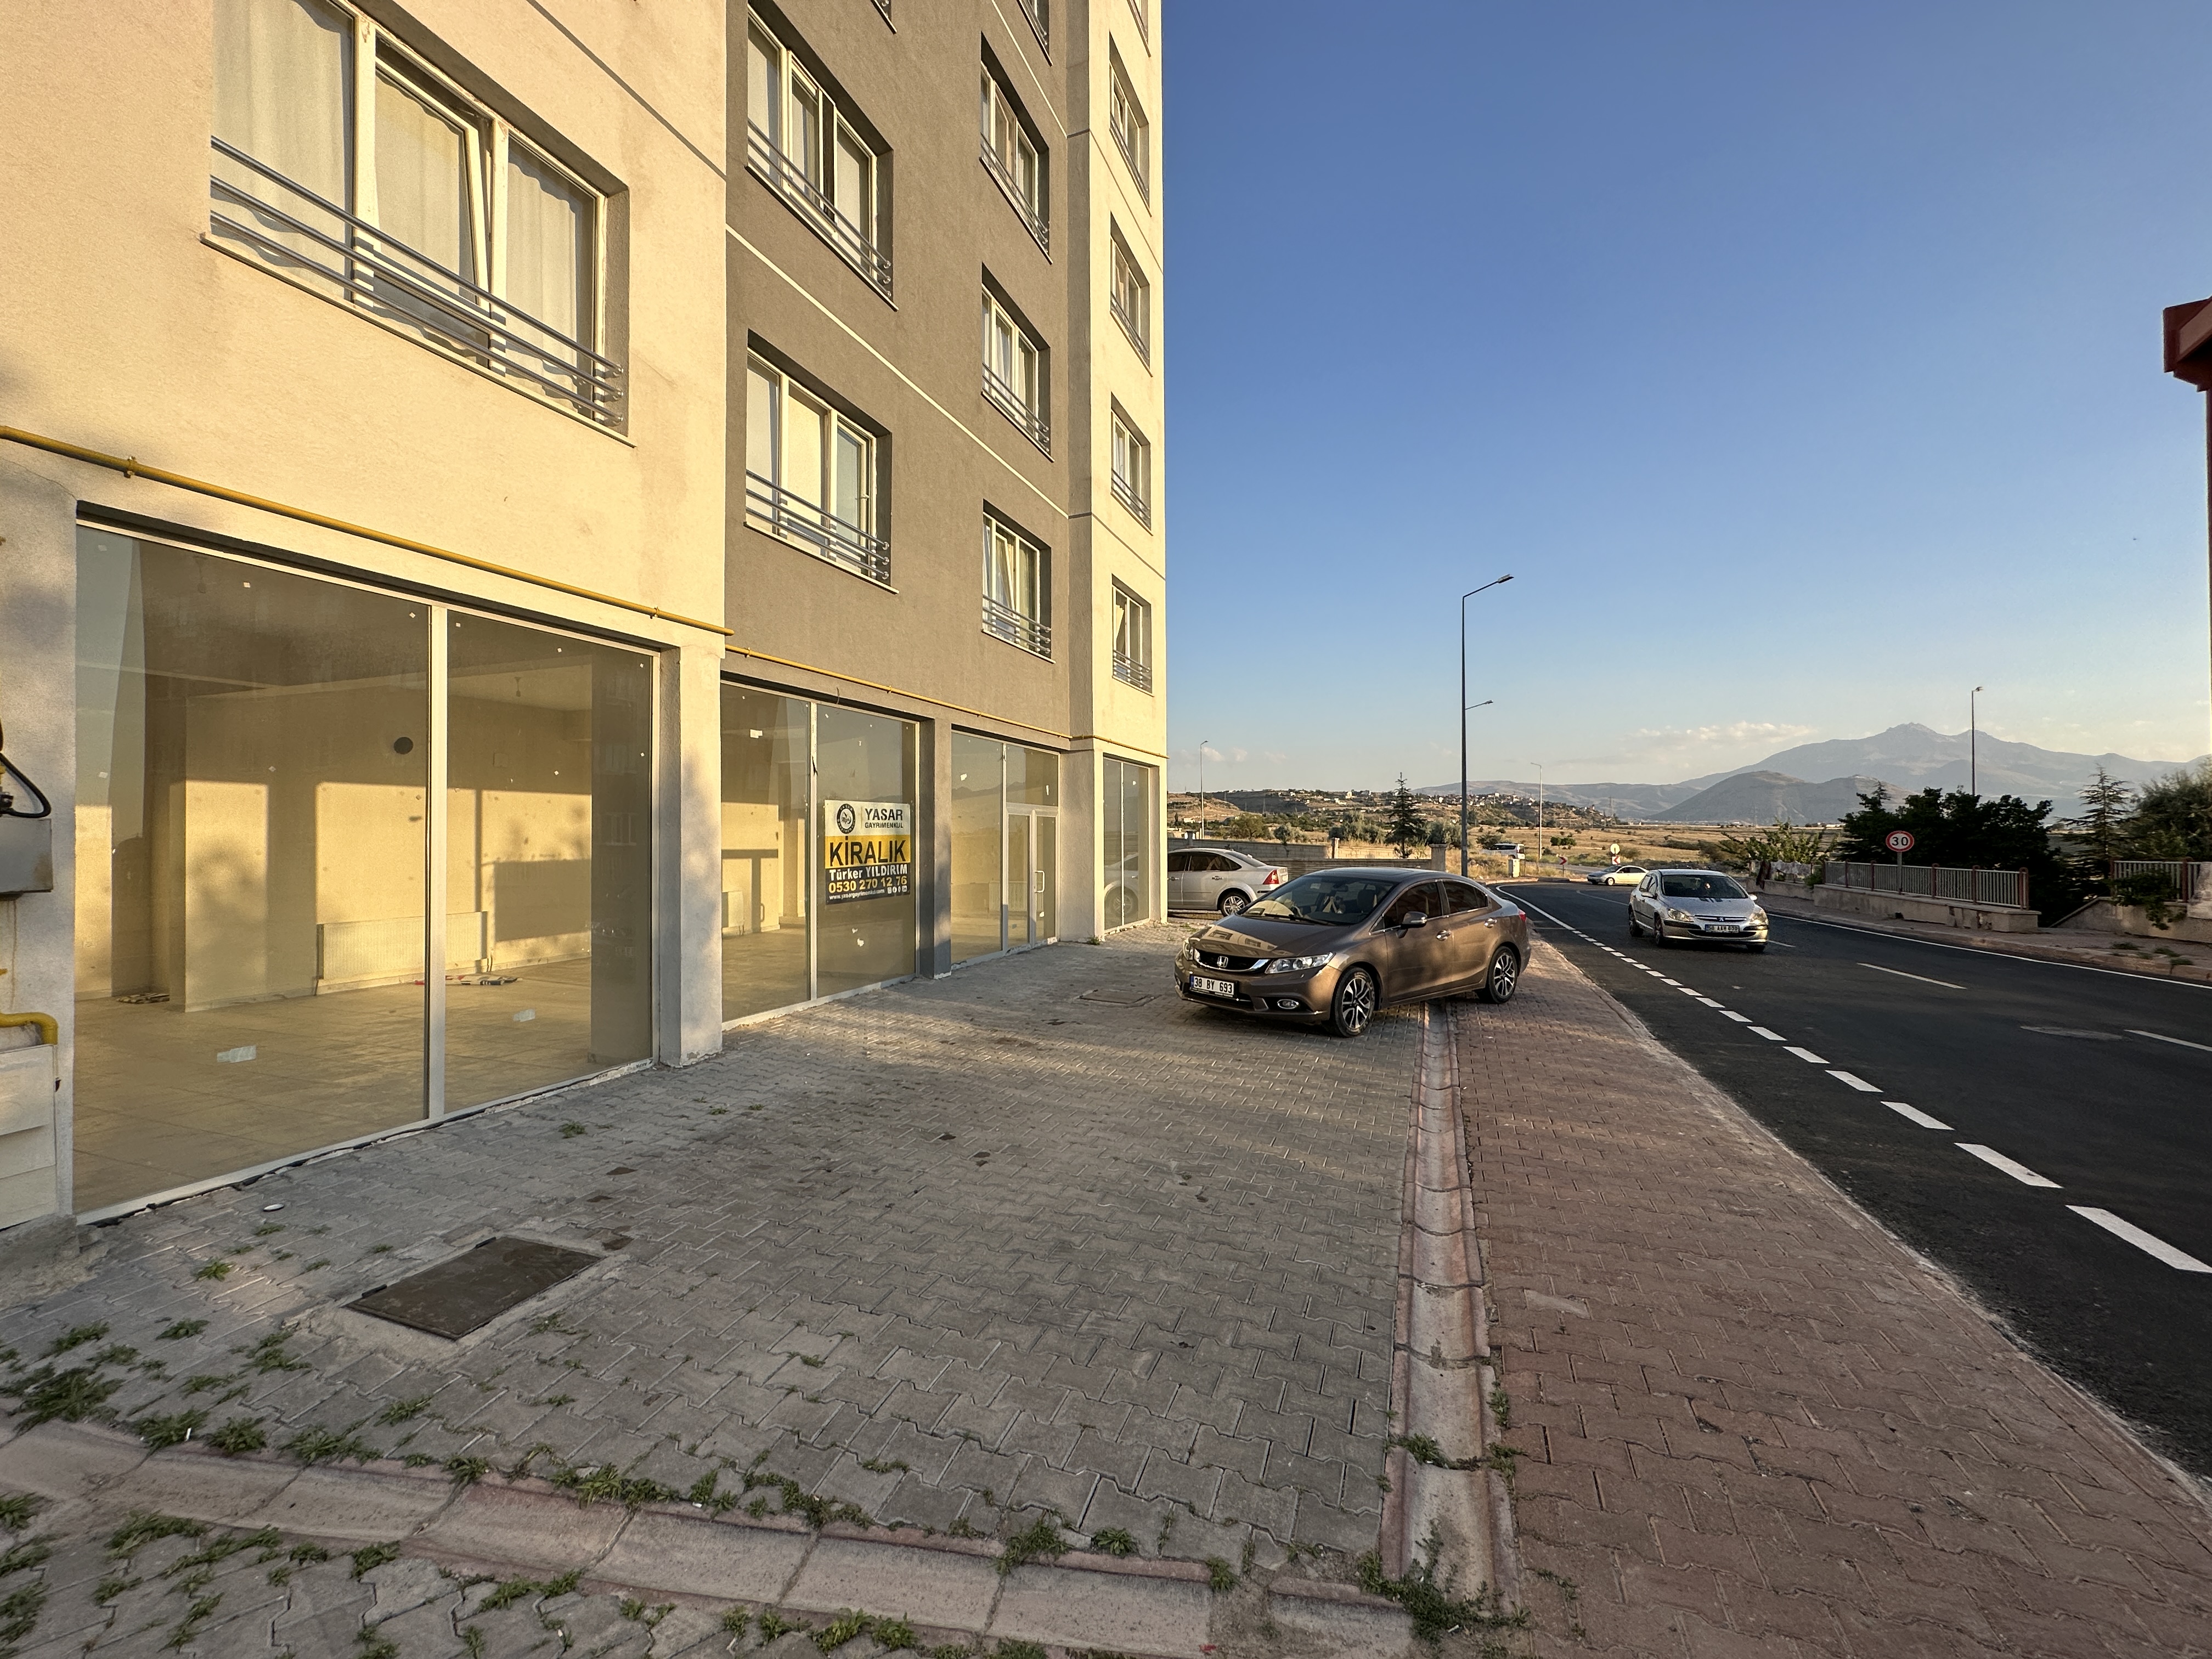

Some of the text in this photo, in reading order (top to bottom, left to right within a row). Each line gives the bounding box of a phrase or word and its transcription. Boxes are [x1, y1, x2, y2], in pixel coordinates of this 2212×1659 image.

[865, 808, 903, 821] YASAR
[1892, 837, 1909, 846] 30
[830, 836, 906, 867] KİRALIK
[829, 864, 907, 881] Türker YILDIRIM
[828, 875, 907, 894] 0530 270 12 76
[1194, 978, 1233, 994] 38 BY 693
